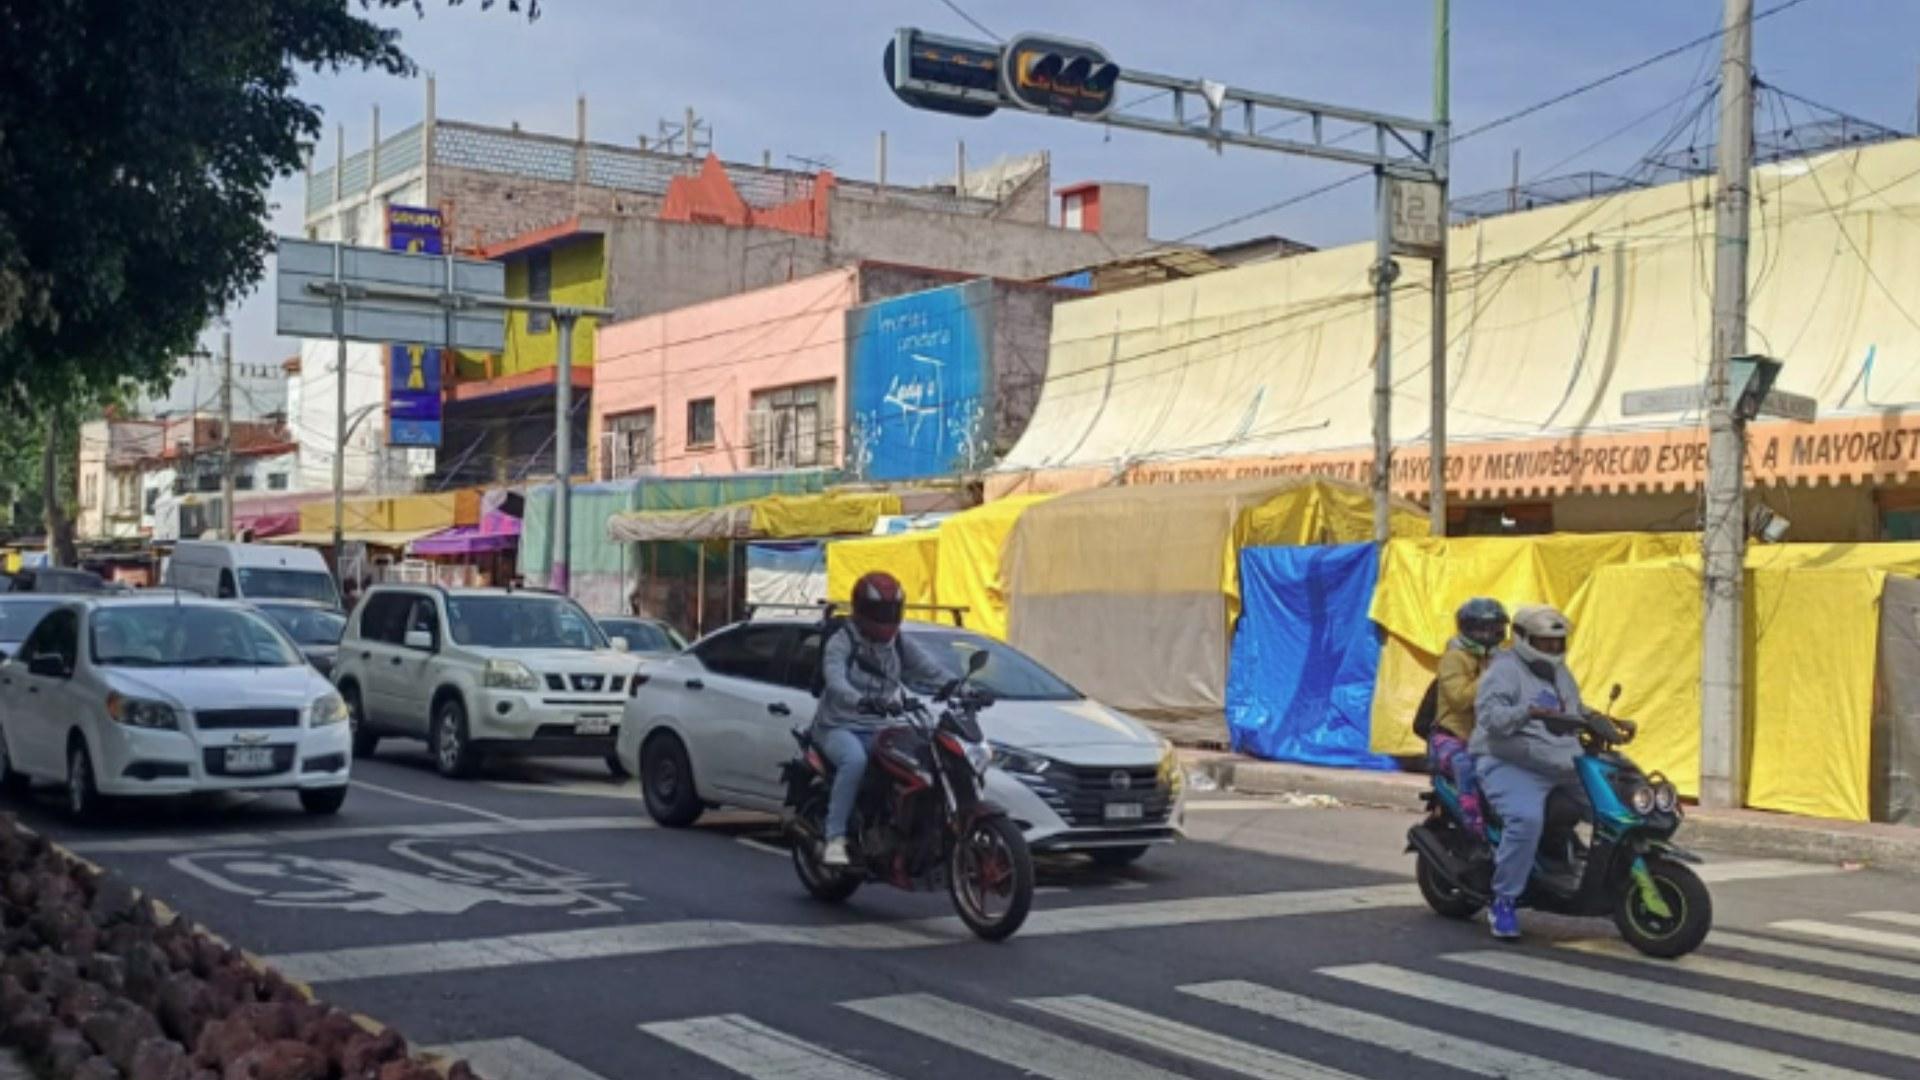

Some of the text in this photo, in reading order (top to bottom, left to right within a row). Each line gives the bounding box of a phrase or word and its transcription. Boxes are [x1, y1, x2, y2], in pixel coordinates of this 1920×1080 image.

[1468, 454, 1482, 480] Y
[1579, 446, 1652, 477] PRECIO
[1761, 436, 1779, 469] A
